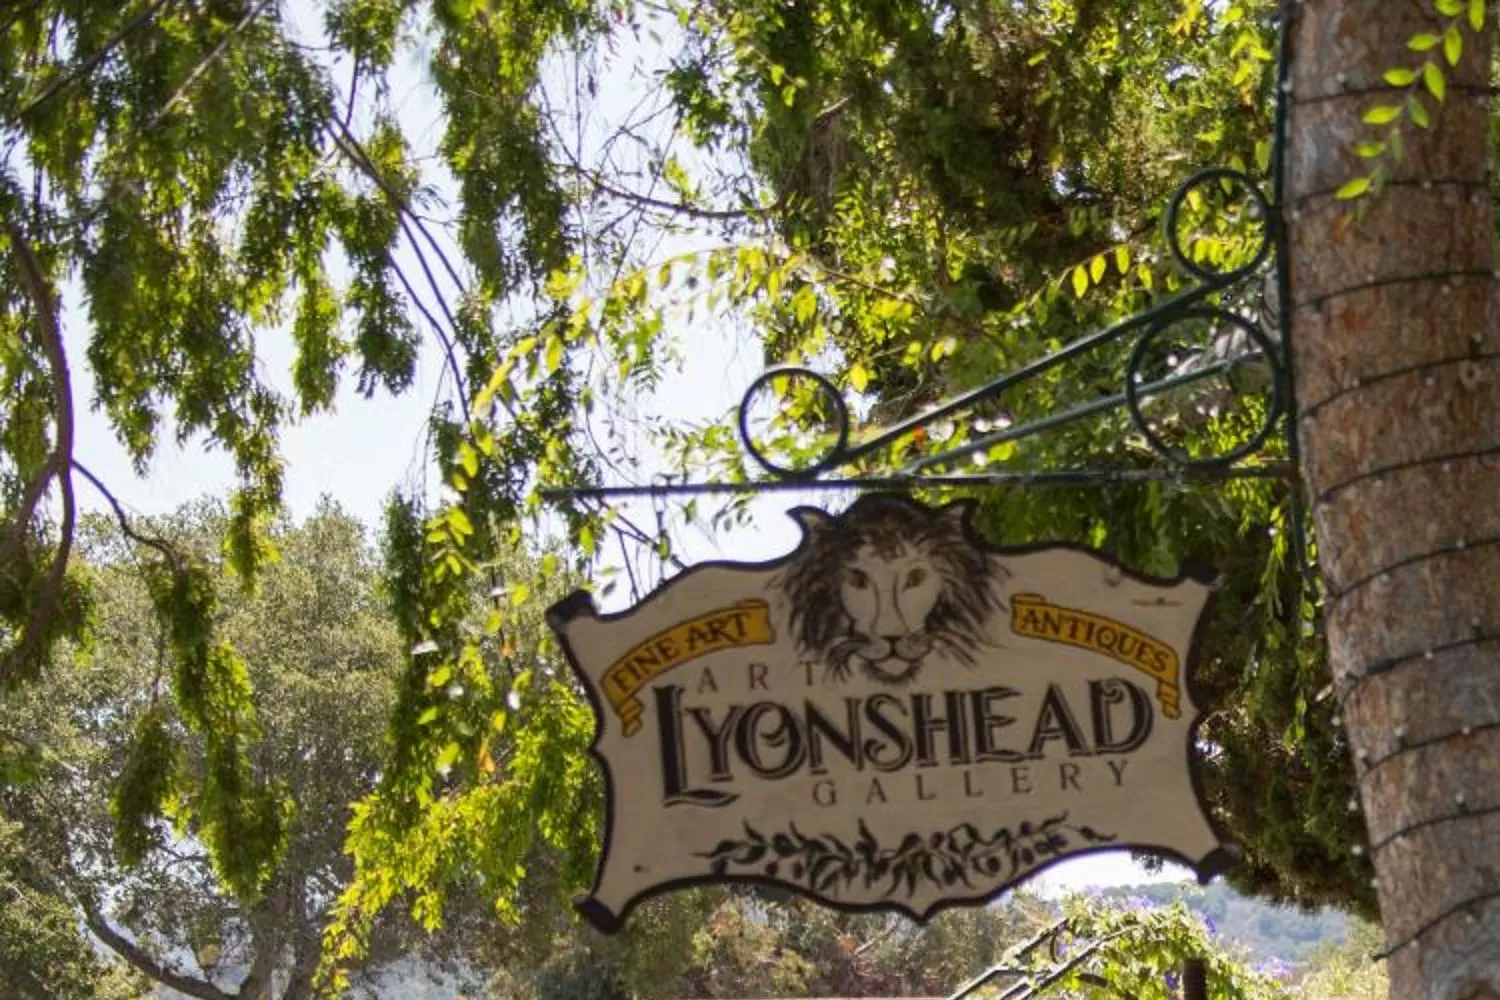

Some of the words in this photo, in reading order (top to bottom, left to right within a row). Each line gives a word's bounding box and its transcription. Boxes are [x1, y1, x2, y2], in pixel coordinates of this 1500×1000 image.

[611, 637, 678, 693] FINE
[684, 611, 750, 650] ART
[1020, 608, 1170, 674] ANTIQUES
[698, 660, 820, 694] ART
[652, 676, 1154, 808] LYONSHEAD
[812, 760, 1128, 807] GALLERY
